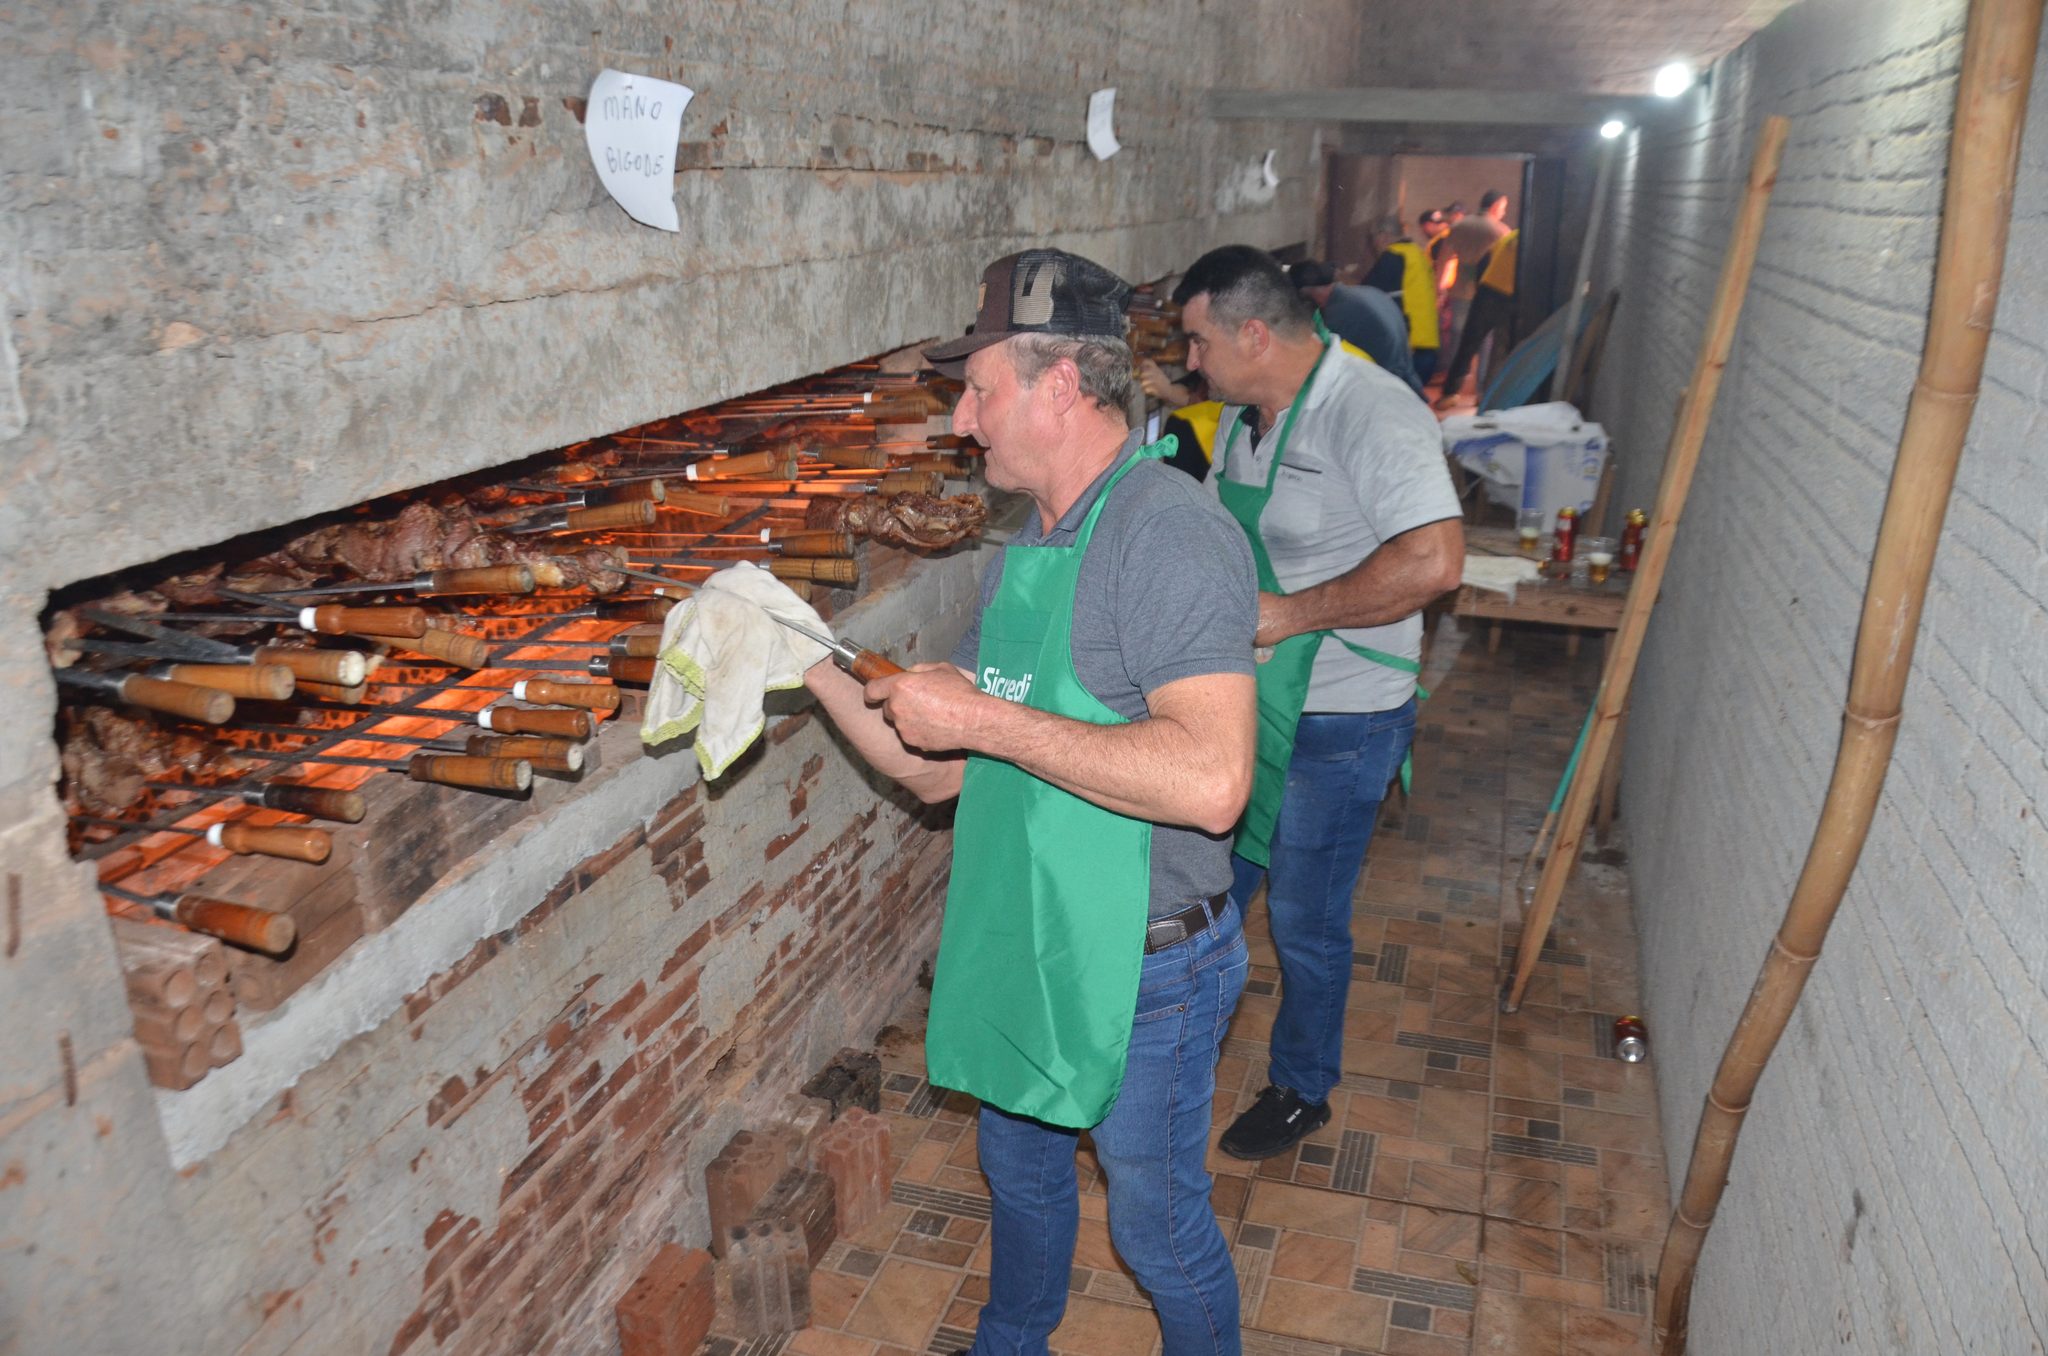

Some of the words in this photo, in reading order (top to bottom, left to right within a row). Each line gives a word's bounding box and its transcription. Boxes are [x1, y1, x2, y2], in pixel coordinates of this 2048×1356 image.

[603, 95, 663, 121] MANO
[606, 146, 665, 178] BIGODE
[981, 666, 1033, 703] Sicredi
